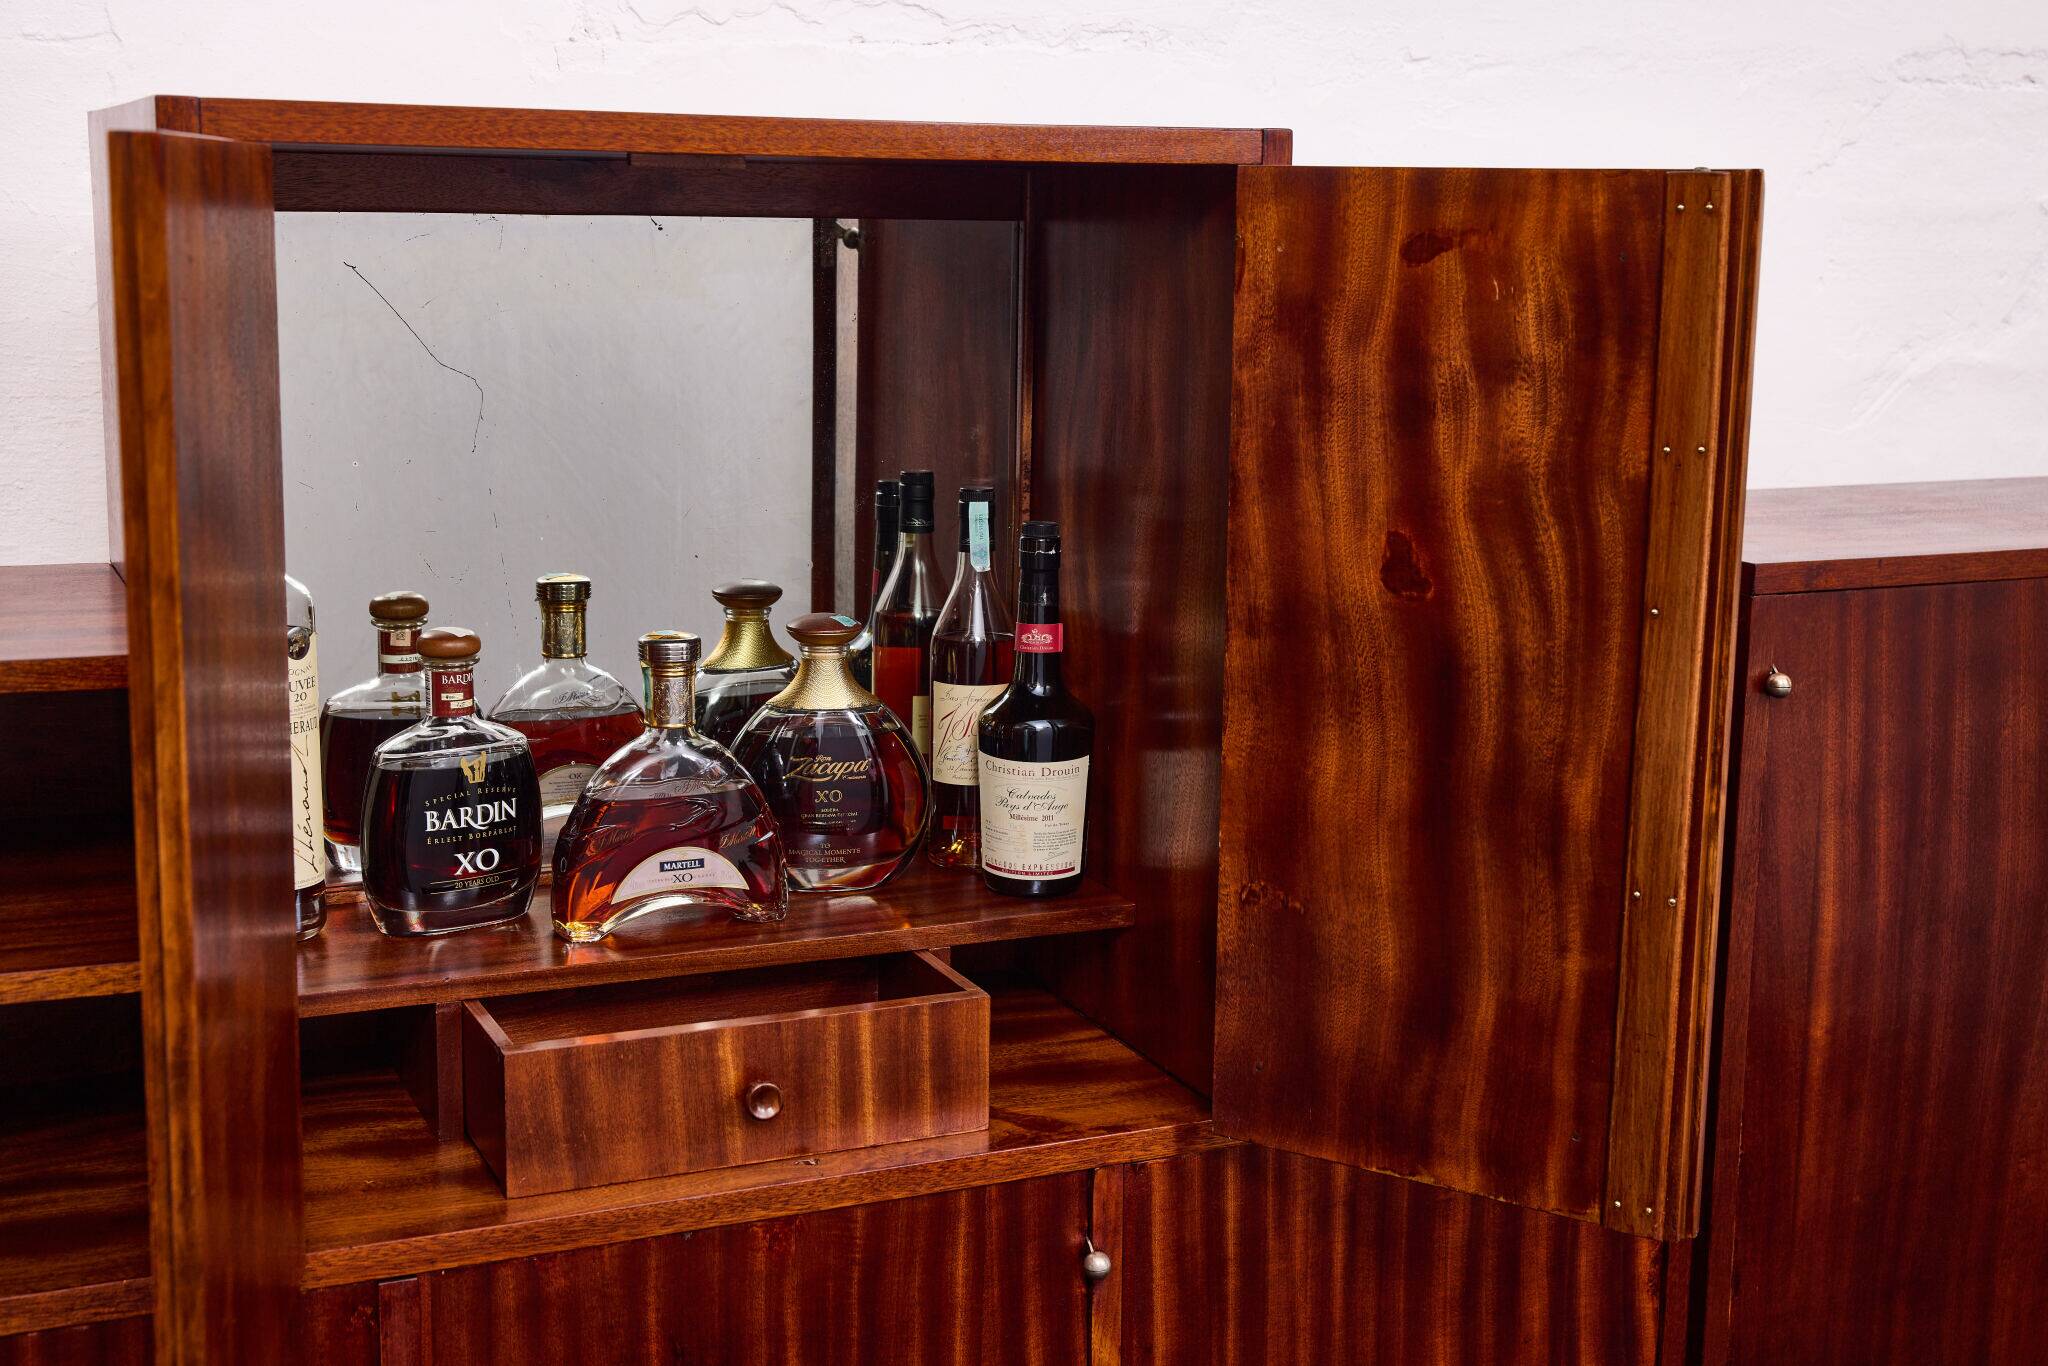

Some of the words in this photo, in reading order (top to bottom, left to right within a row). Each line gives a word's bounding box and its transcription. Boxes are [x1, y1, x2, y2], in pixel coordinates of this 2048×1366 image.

[441, 672, 474, 685] BARDI
[783, 756, 871, 782] Zacapa
[986, 759, 1036, 778] Christian
[1041, 765, 1081, 778] Drouin
[814, 789, 843, 803] XO
[1006, 786, 1057, 801] Calvados
[995, 796, 1021, 814] Pays
[424, 798, 517, 832] BARDIN
[1042, 814, 1055, 822] 2011
[824, 848, 861, 857] MOMENTS
[454, 848, 500, 876] XO
[663, 859, 702, 871] MARTELL
[672, 872, 693, 884] XO
